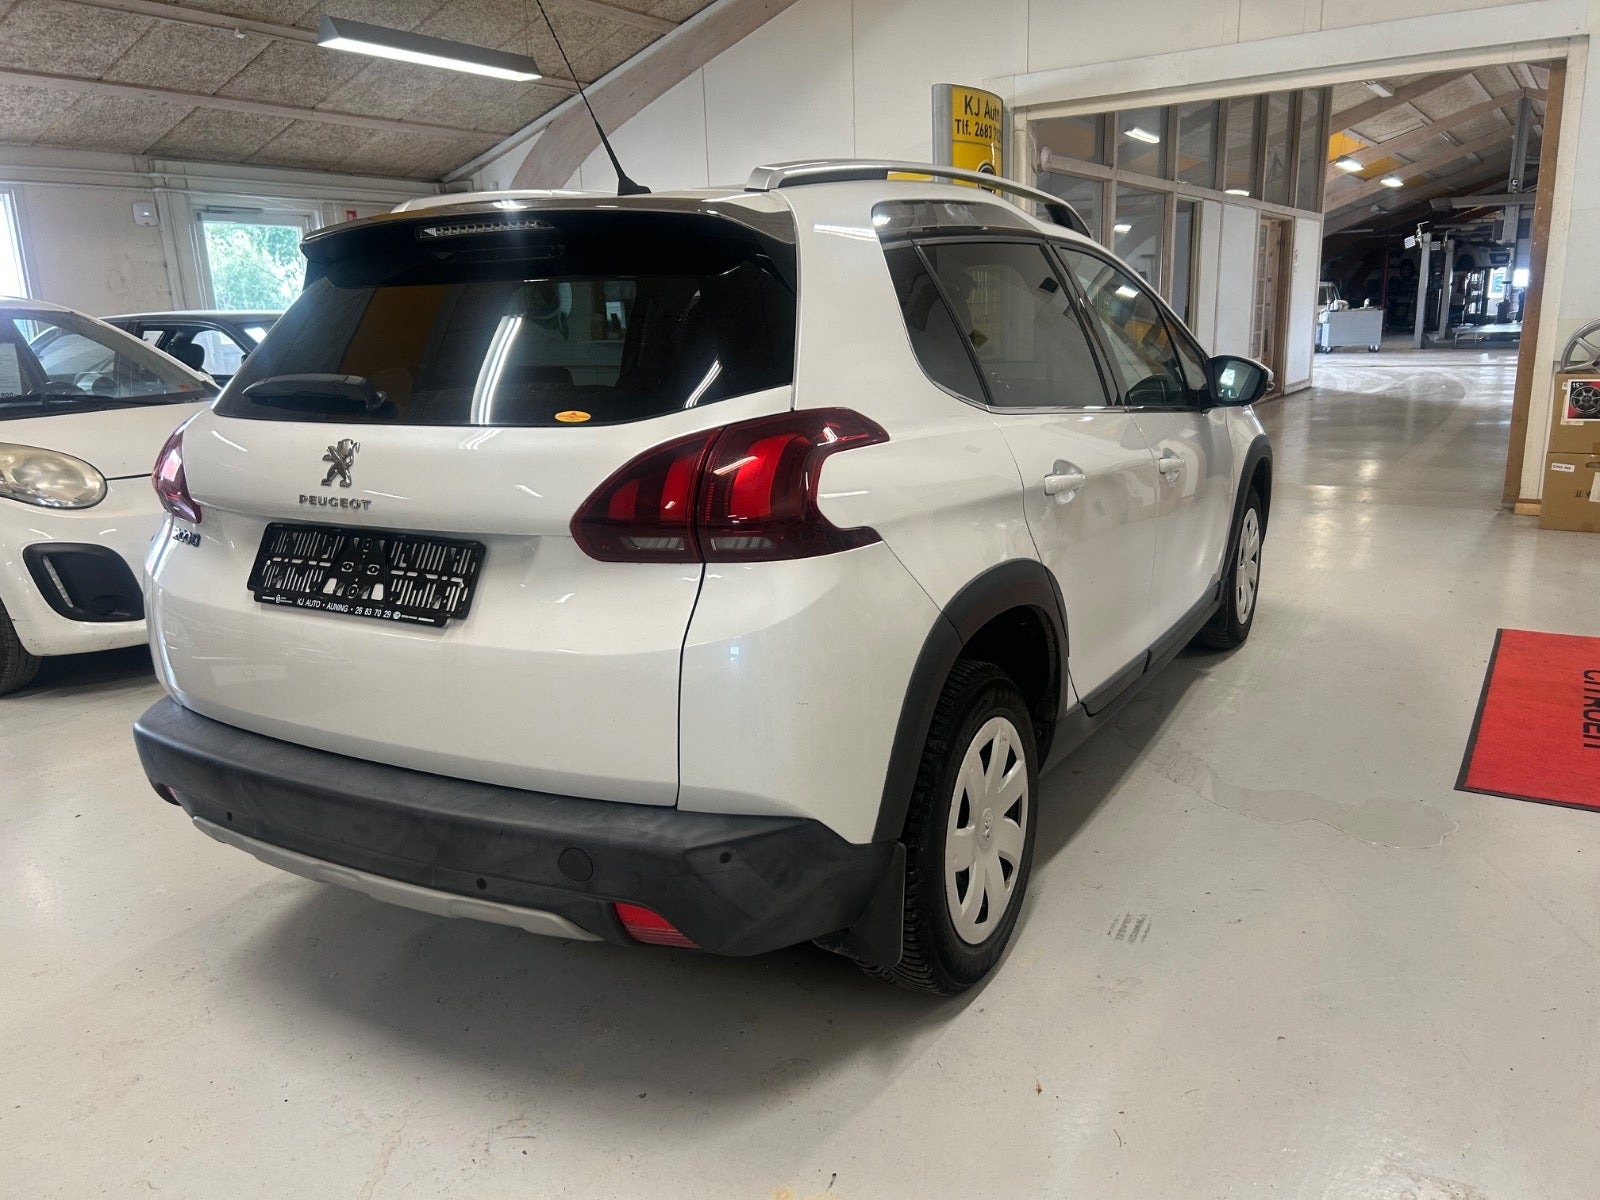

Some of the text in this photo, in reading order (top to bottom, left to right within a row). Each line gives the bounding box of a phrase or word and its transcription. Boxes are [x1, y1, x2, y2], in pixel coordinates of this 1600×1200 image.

[964, 95, 980, 116] KJ
[955, 119, 971, 136] Tlf.
[975, 122, 992, 139] 2683
[299, 494, 372, 511] PEUGEOT
[297, 597, 305, 606] KJ
[305, 599, 321, 608] AUTO
[326, 602, 349, 613] AUNING
[355, 606, 364, 615] 26
[364, 607, 373, 616] 83
[374, 608, 382, 617] 70
[383, 610, 392, 618] 29
